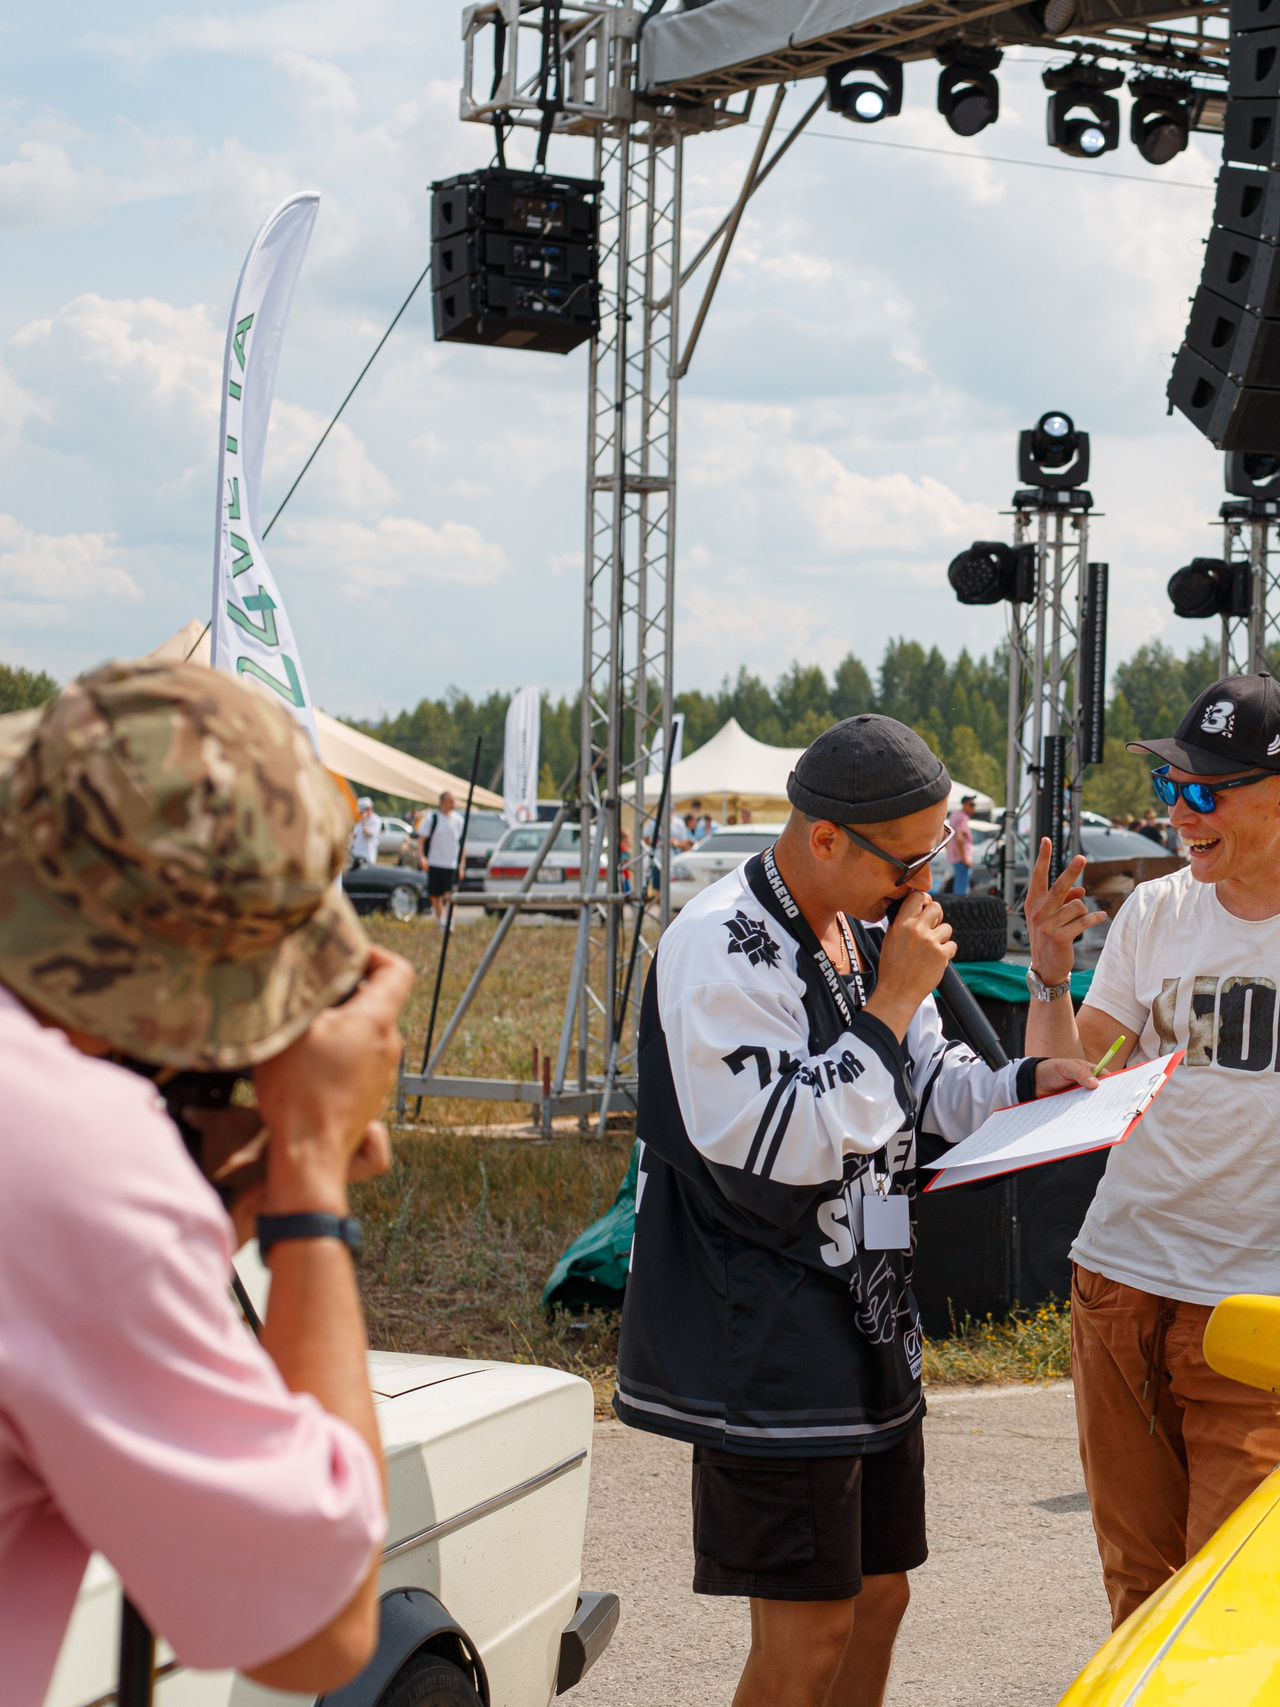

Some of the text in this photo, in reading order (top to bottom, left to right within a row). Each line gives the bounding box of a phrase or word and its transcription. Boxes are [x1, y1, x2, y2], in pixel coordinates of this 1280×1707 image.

[762, 846, 800, 919] WEEKEND
[813, 949, 852, 1027] PERM AUT
